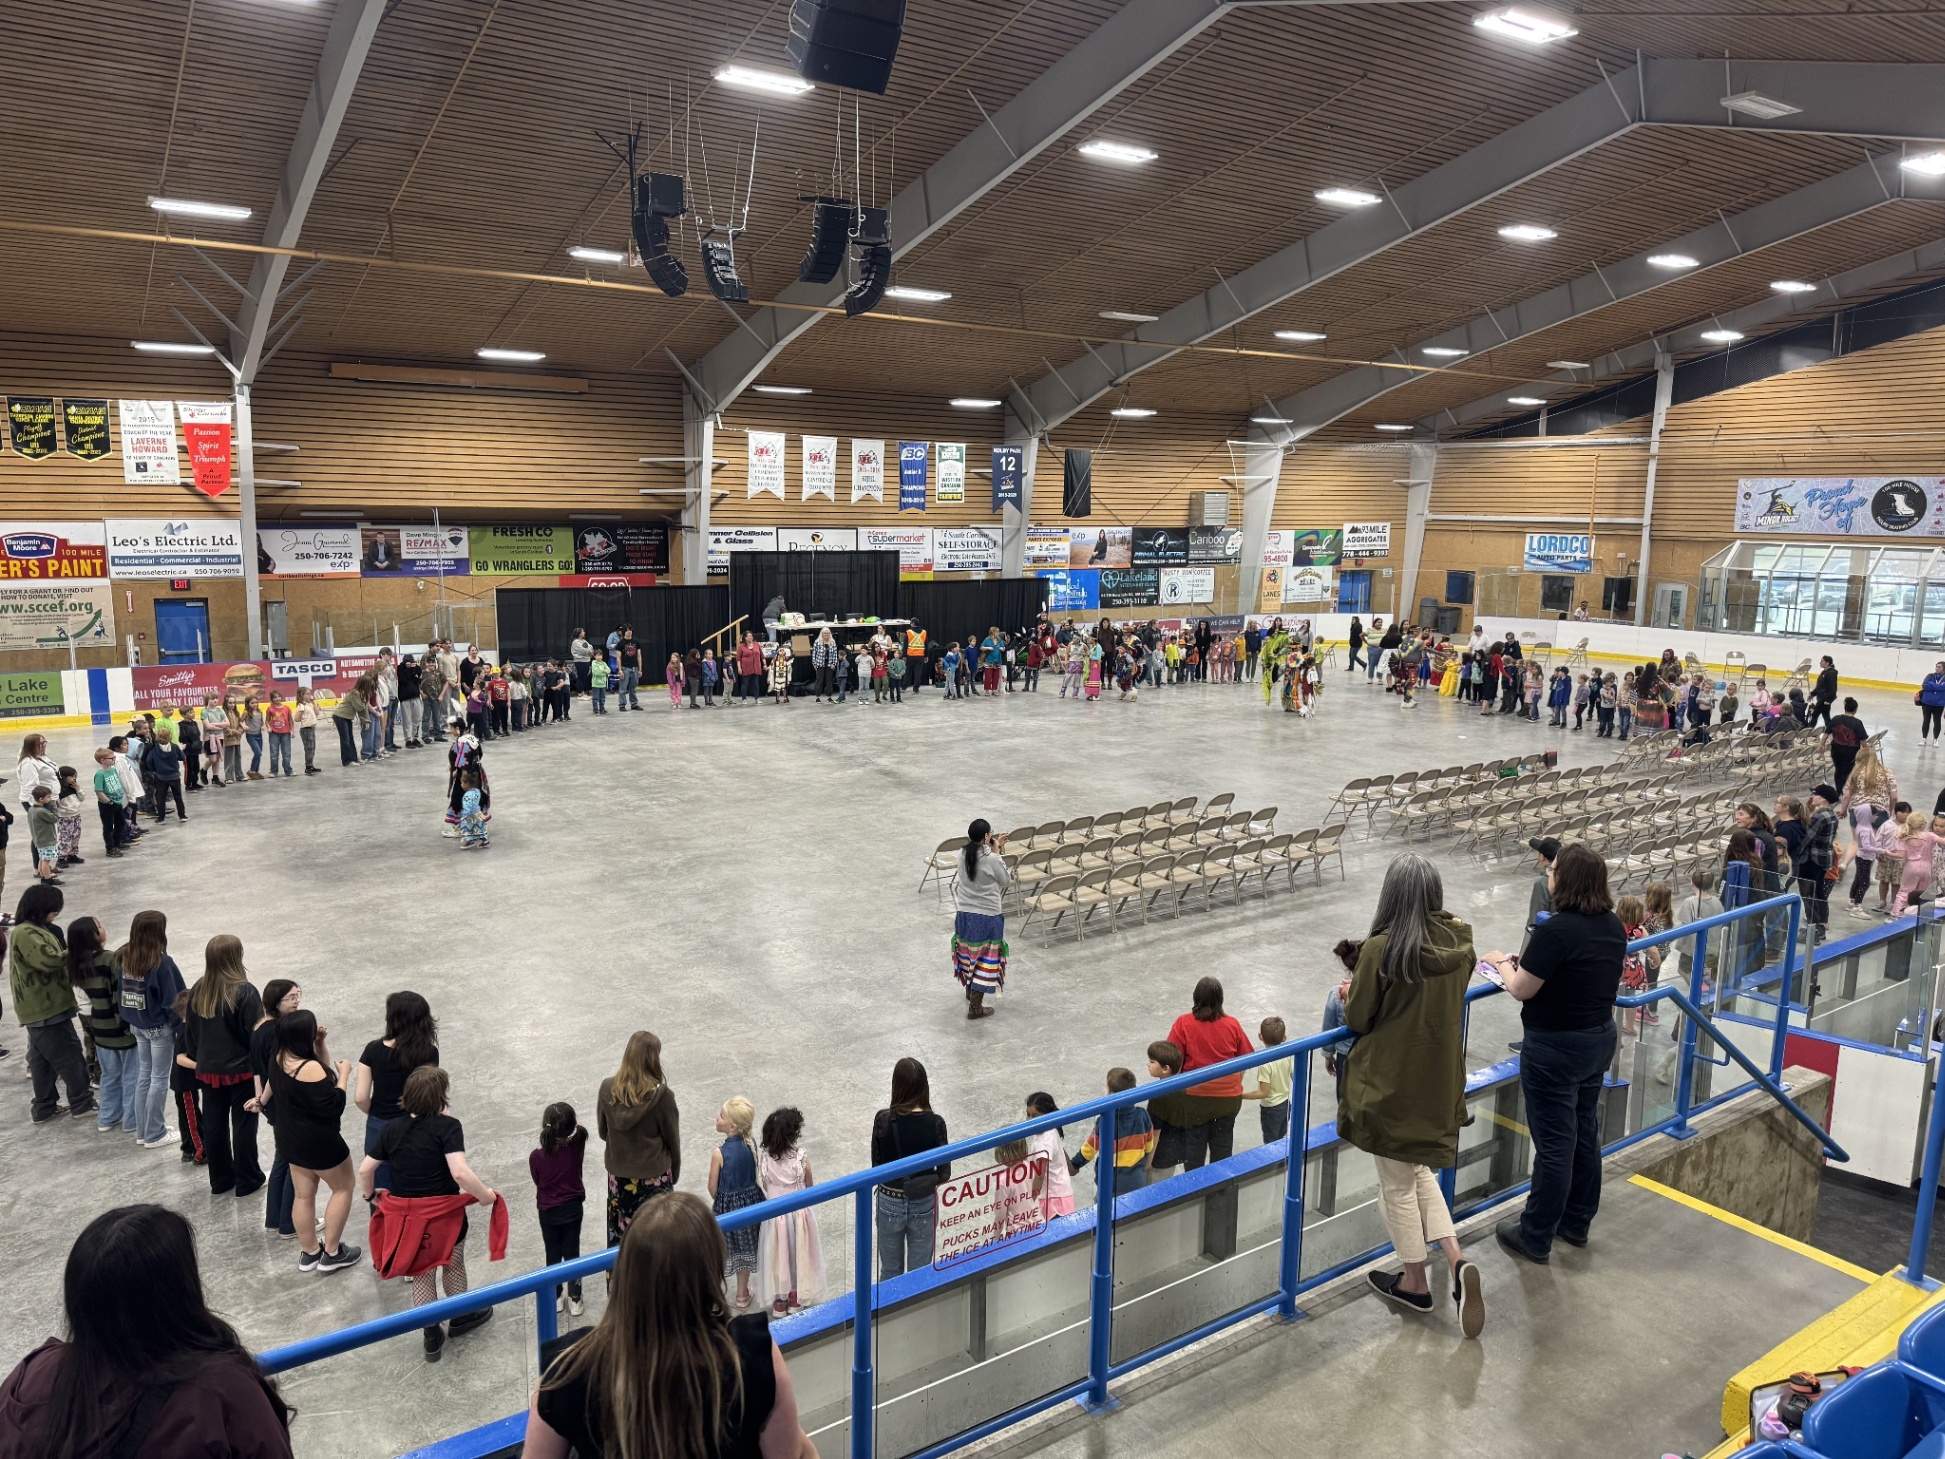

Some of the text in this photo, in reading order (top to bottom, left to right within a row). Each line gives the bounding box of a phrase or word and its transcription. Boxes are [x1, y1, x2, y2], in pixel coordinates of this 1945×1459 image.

[17, 430, 51, 444] Champions
[72, 432, 105, 444] Champions
[198, 442, 219, 450] Spirit
[194, 455, 226, 463] Triumph
[1000, 456, 1016, 470] 12
[1804, 479, 1854, 508] Proud
[6, 538, 40, 547] Benjamin
[112, 534, 238, 547] Leo's Electric Ltd.
[406, 539, 447, 547] RE/MAX
[872, 534, 926, 545] supermarket
[938, 539, 999, 549] SELF-STORAGE
[1528, 535, 1590, 554] LORDCO
[789, 542, 848, 550] REGENCY
[295, 552, 353, 560] 250-706-7242
[47, 559, 103, 577] PAINT
[475, 560, 489, 571] GO
[493, 560, 554, 571] WRANGLERS
[558, 560, 573, 571] GO!
[1120, 571, 1158, 582] Lakeland
[174, 580, 188, 588] EXIT
[276, 663, 334, 674] TASCO
[158, 670, 196, 687] Smitty's
[8, 678, 48, 691] Lake
[5, 694, 49, 704] Centre
[135, 690, 148, 699] ALL
[150, 689, 172, 698] YOUR
[184, 697, 204, 706] LONG
[942, 1160, 1043, 1207] CAUTION
[940, 1188, 1041, 1229] KEEP AN EYE ON PLAY
[942, 1207, 1039, 1249] PUCKS MAY LEAVE
[939, 1220, 1043, 1264] THE ICE AT ANYTIME
